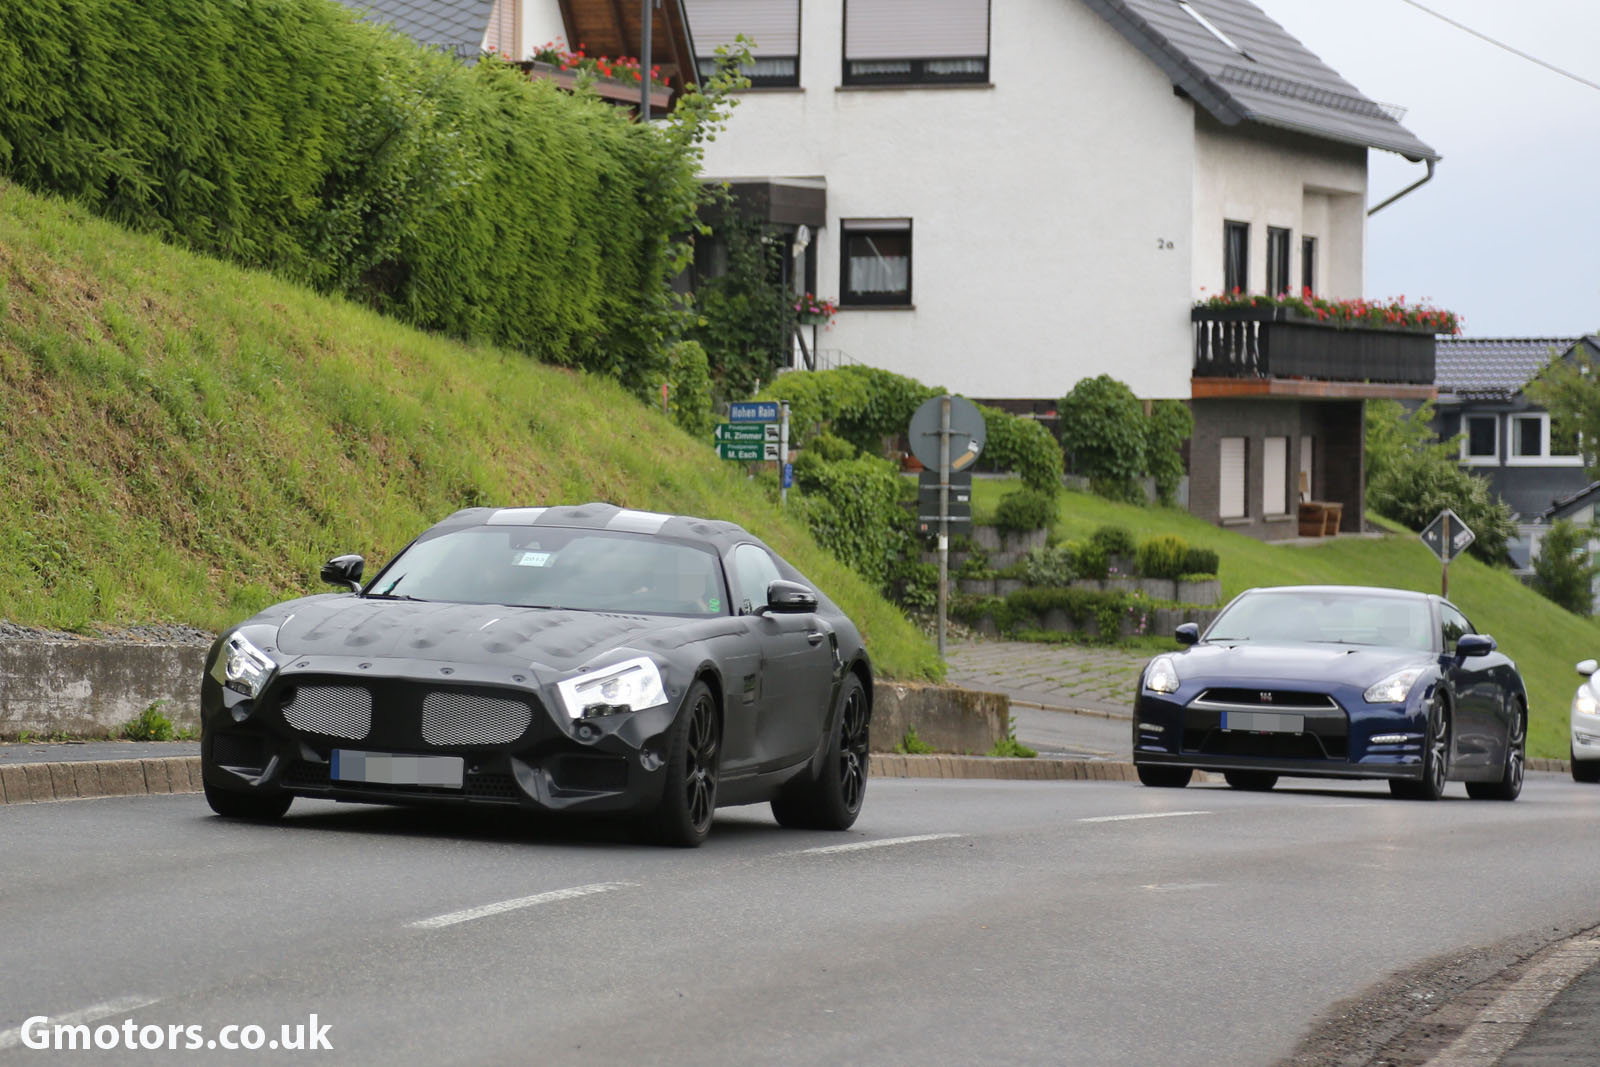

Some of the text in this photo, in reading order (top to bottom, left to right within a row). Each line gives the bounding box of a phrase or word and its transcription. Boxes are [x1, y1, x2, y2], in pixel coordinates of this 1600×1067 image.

[731, 405, 776, 418] Hohen Rain
[734, 431, 763, 440] Zimmer
[738, 450, 758, 459] Esch
